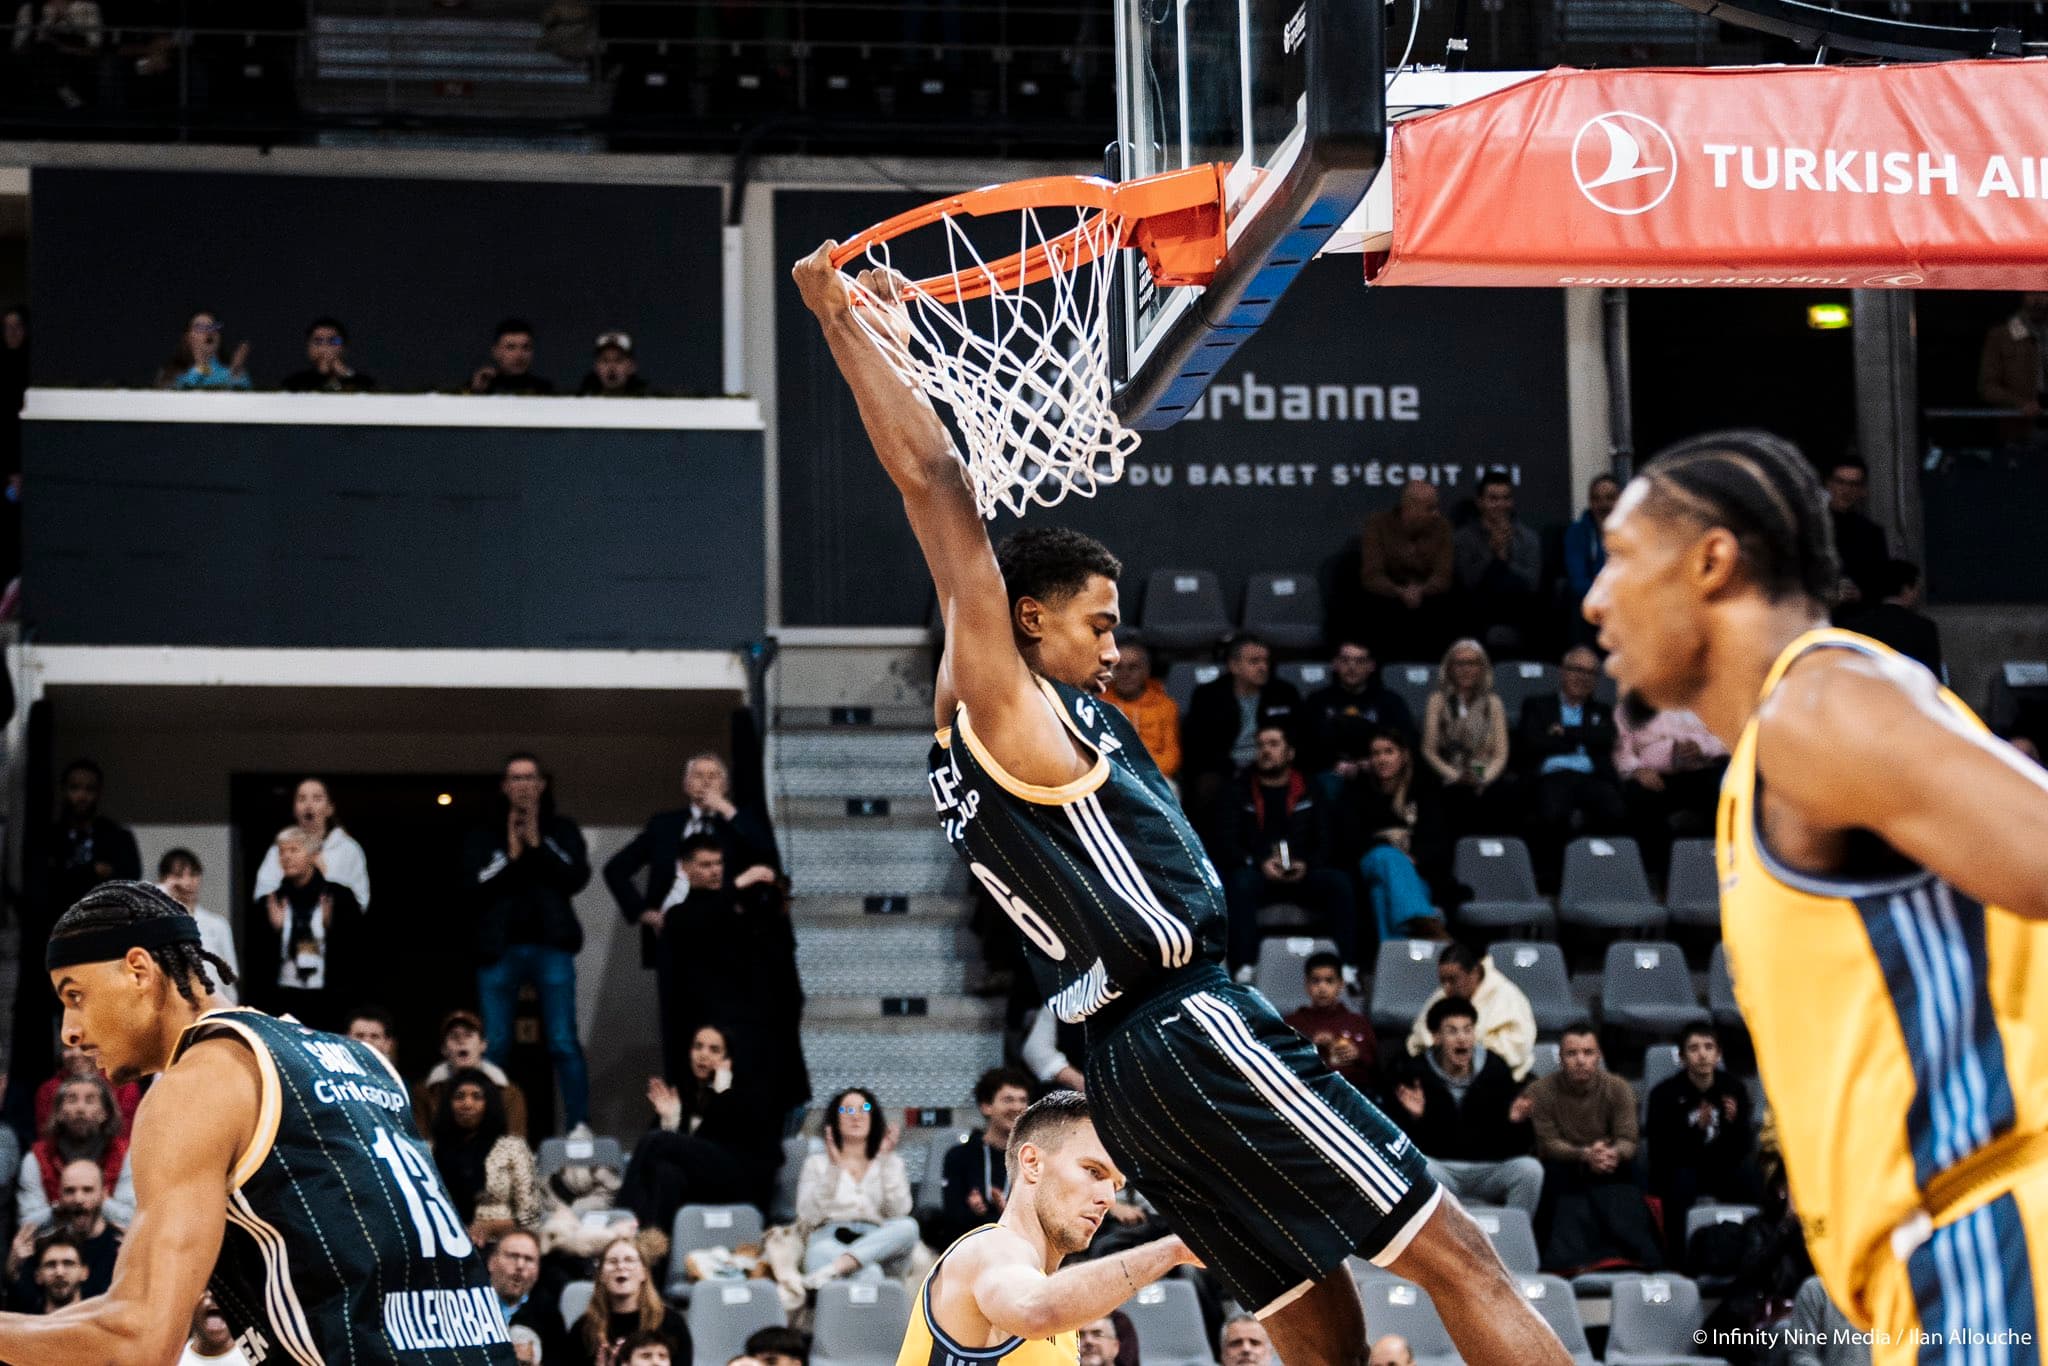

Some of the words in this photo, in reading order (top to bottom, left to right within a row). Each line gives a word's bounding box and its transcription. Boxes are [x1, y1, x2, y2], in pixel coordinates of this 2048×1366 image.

[1703, 144, 1959, 196] TURKISH
[1129, 464, 1173, 486] DU
[1187, 464, 1318, 486] BASKET
[970, 861, 1067, 961] 6
[373, 1126, 473, 1258] 13
